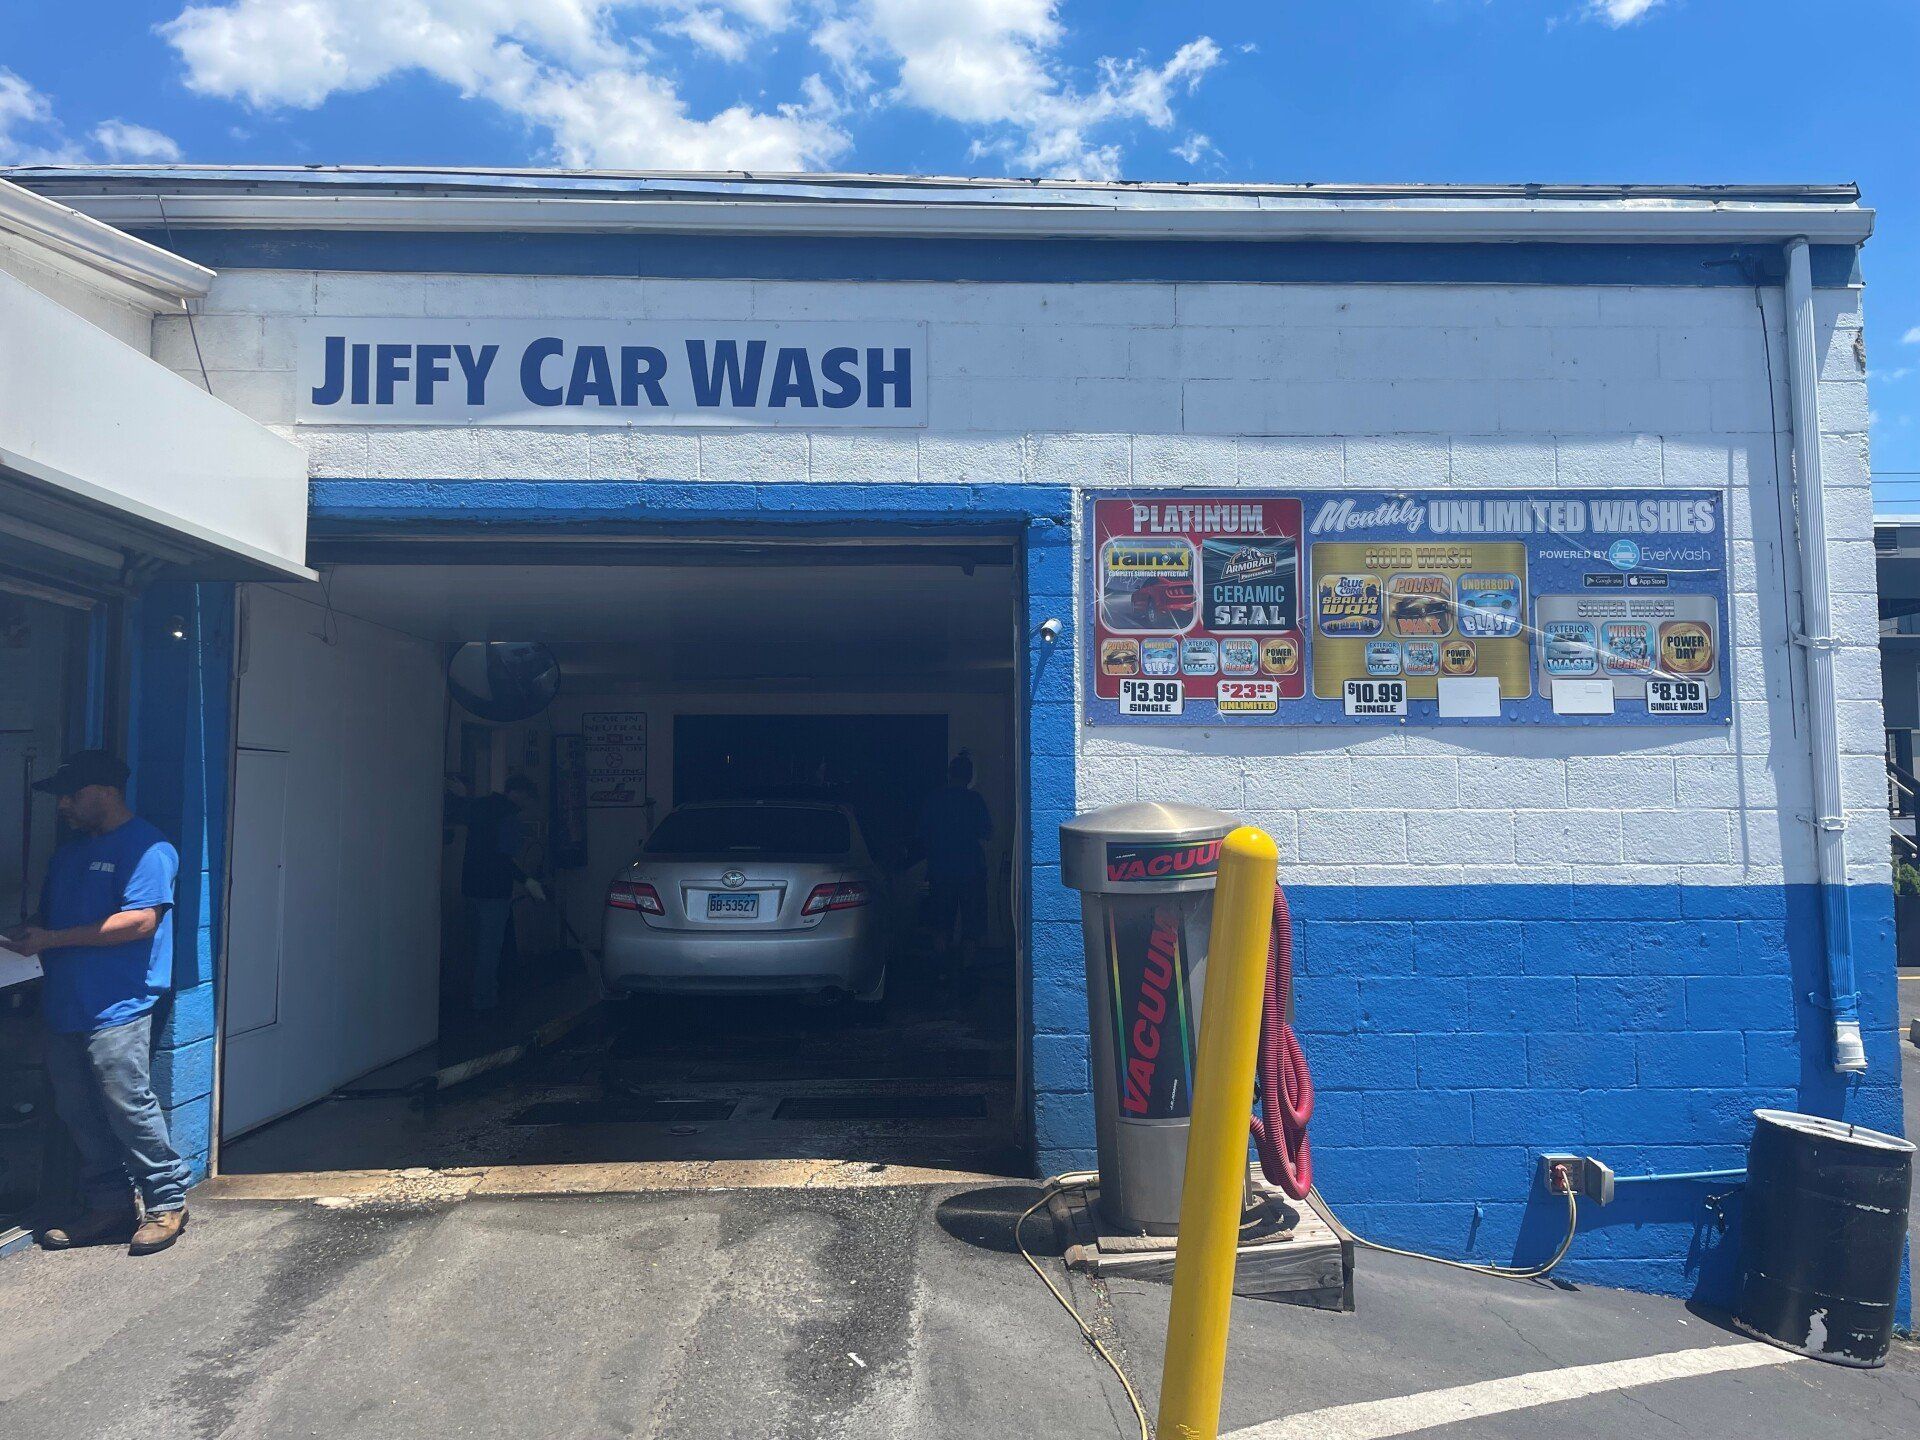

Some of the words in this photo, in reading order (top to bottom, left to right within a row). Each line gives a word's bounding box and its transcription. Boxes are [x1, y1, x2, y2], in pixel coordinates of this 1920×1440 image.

[312, 336, 500, 406] JIFFY
[519, 337, 669, 407] CAR
[685, 339, 912, 408] WASH
[1133, 505, 1263, 533] PLATINUM
[1309, 498, 1426, 534] Monthly
[1429, 500, 1586, 534] UNLIMITED
[1589, 500, 1716, 534] WASHES
[1365, 547, 1413, 569] GOLD
[1417, 547, 1473, 569] WASH
[1539, 550, 1591, 559] POWERED
[1593, 550, 1607, 559] BY
[1641, 547, 1711, 561] EverWash
[1395, 578, 1444, 593] POLISH
[1462, 579, 1514, 591] UNDERBODY
[1213, 585, 1285, 603] CERAMIC
[1215, 606, 1286, 625] SEAL
[1577, 600, 1627, 618] SILVER
[1630, 600, 1675, 618] WASH
[1398, 618, 1443, 635] WAX
[1461, 614, 1518, 631] BLAST
[1549, 625, 1590, 633] EXTERIOR
[1607, 625, 1647, 638] WHEELS
[1225, 641, 1253, 650] WHEELS
[1408, 642, 1433, 651] WHEELS
[1667, 636, 1704, 647] POWER
[1266, 648, 1292, 657] POWER
[1446, 649, 1470, 658] POWER
[1675, 648, 1697, 660] DRY
[1271, 656, 1287, 665] DRY
[1451, 657, 1466, 666] DRY
[1548, 658, 1595, 671] WASH
[1123, 681, 1178, 702] $13.99
[1347, 682, 1403, 703] $10.99
[1652, 682, 1700, 701] $8.99
[1129, 703, 1171, 712] SINGLE
[1219, 701, 1277, 711] UNLIMITED
[1354, 705, 1397, 713] SINGLE
[1650, 702, 1679, 711] SINGLE
[1680, 702, 1704, 711] WASH
[1123, 906, 1179, 1114] VACUUM
